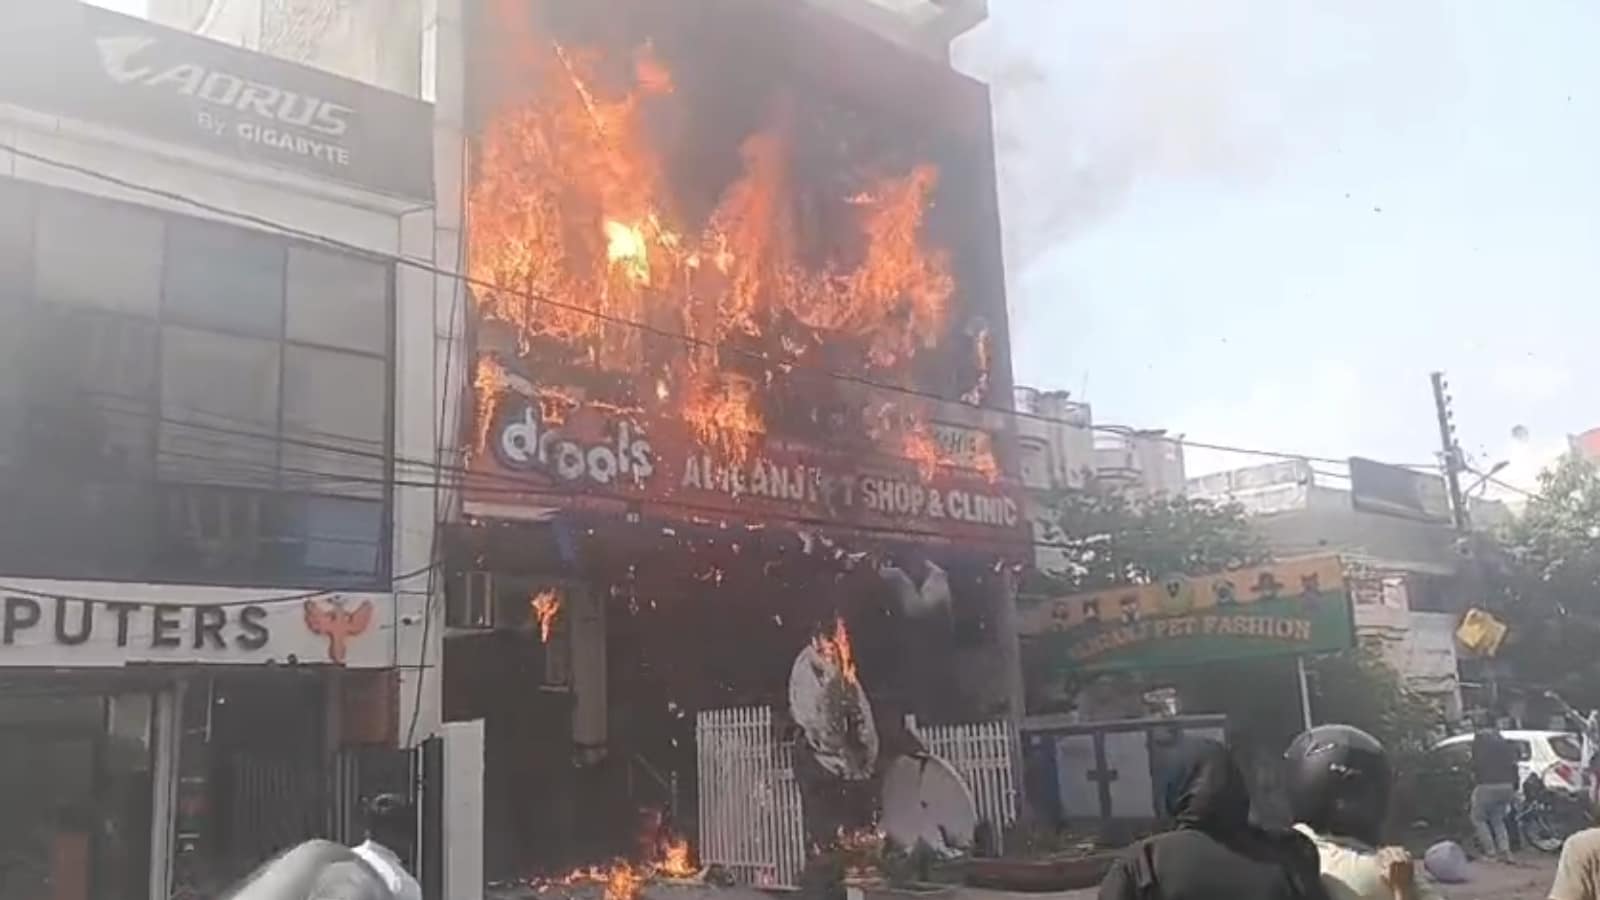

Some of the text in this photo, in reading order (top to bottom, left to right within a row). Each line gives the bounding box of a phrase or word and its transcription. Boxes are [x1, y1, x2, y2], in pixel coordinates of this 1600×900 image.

[144, 62, 355, 135] AORUS
[198, 111, 350, 165] By GIGABYTE
[502, 406, 654, 484] drools
[862, 477, 926, 515] SHOP
[927, 488, 946, 518] &
[947, 490, 1018, 527] CLINIC
[2, 596, 270, 650] PUTERS
[1154, 617, 1198, 638] PET
[1203, 615, 1311, 641] FASHION
